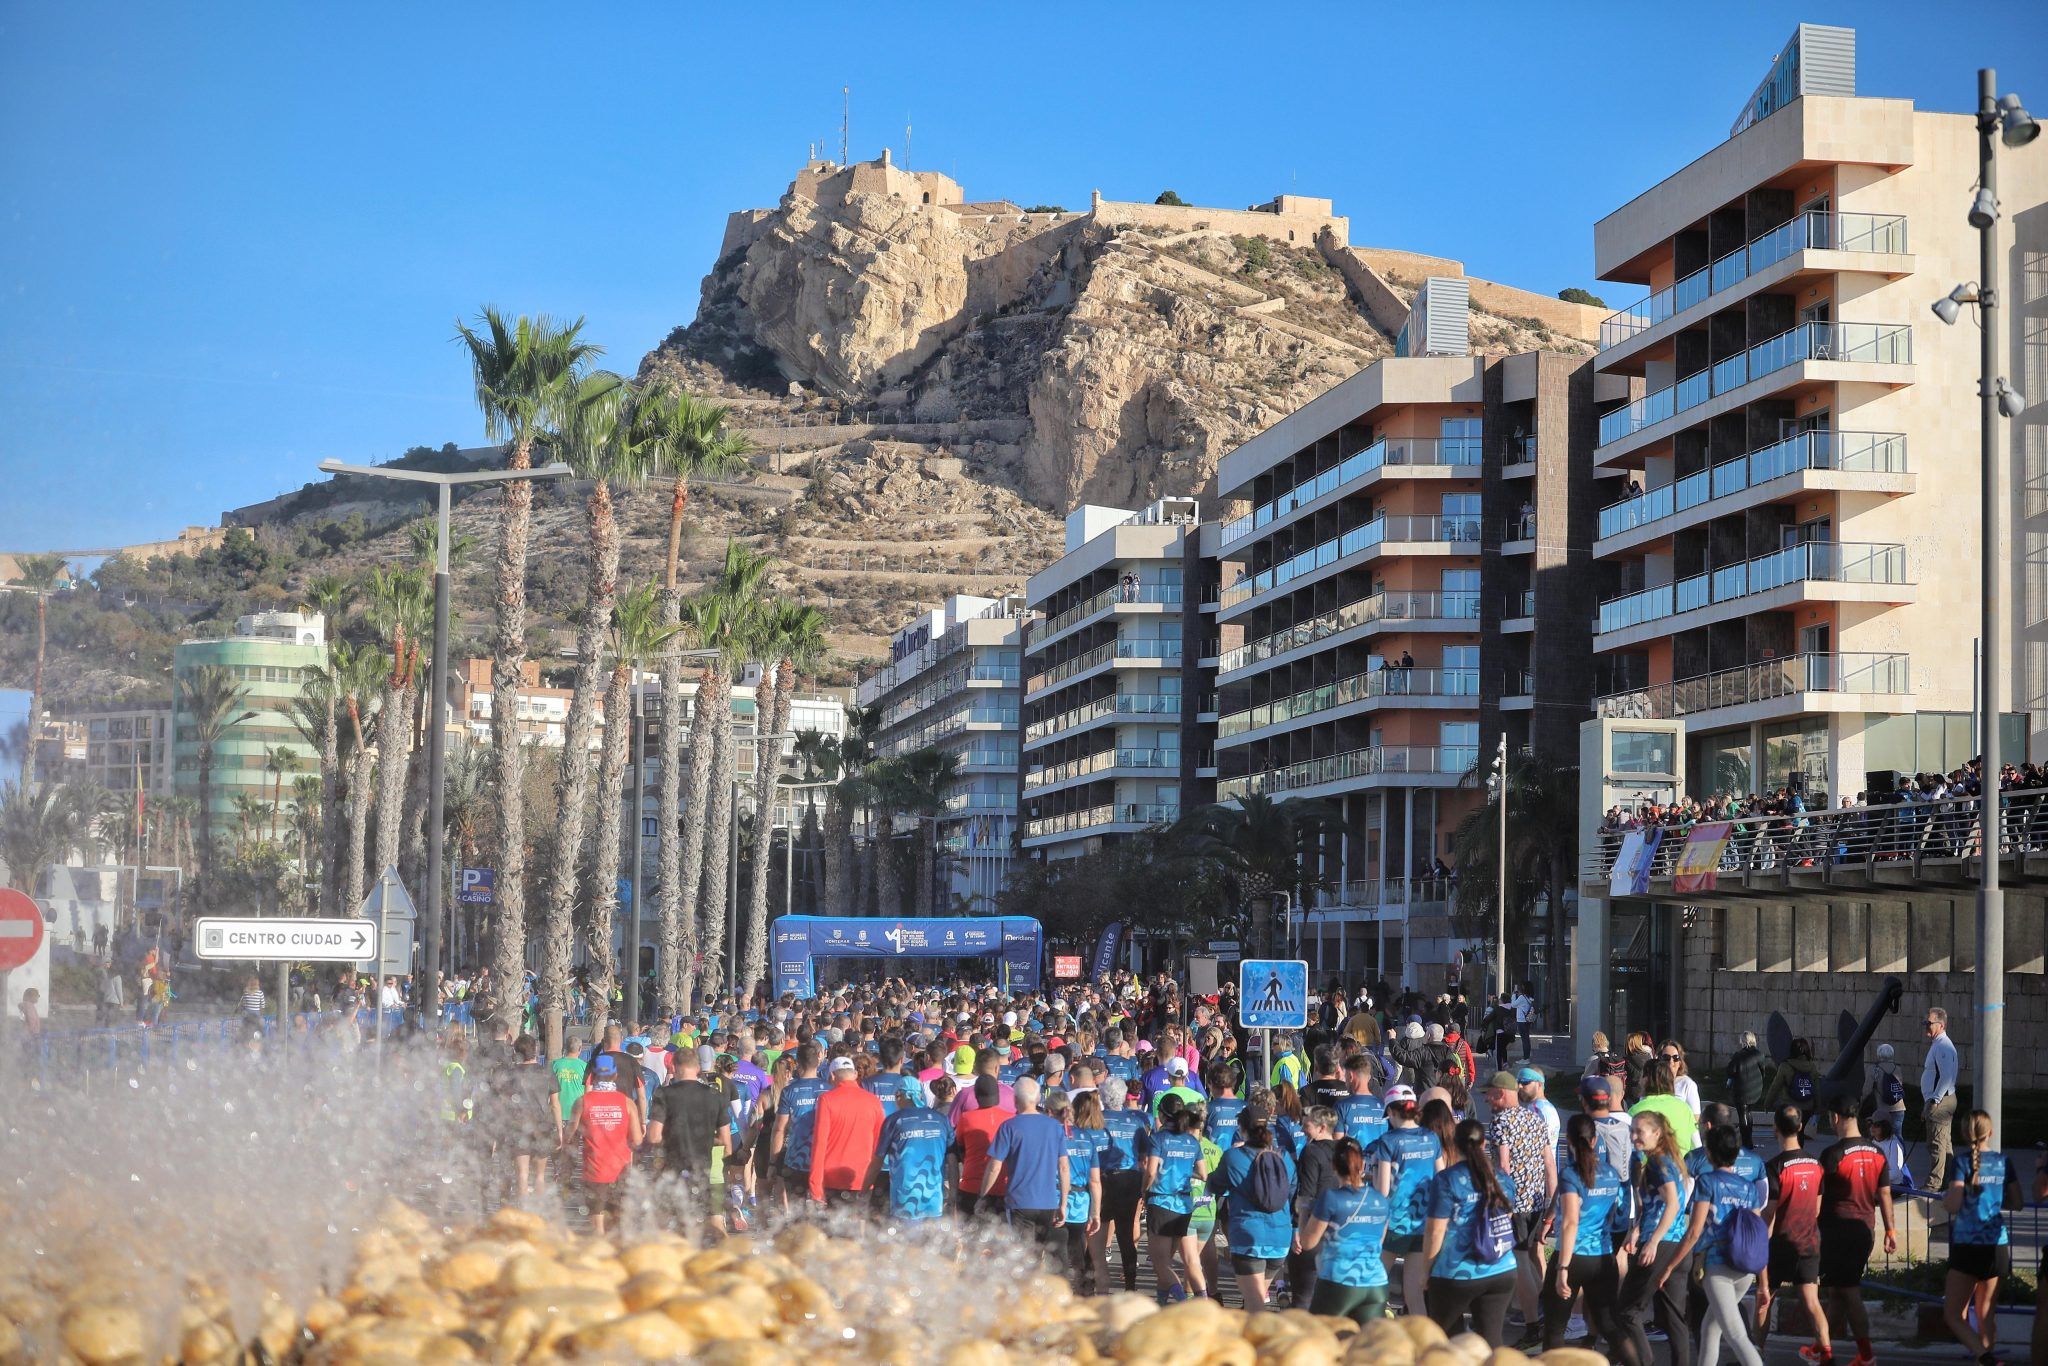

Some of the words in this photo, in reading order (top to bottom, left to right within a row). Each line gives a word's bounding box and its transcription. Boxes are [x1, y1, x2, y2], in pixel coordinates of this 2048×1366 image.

[463, 869, 480, 891] P
[229, 932, 286, 944] CENTRO
[291, 934, 342, 945] CIUDAD
[1353, 1116, 1374, 1124] ALICANTE
[900, 1129, 925, 1140] ALICANTE
[1166, 1150, 1185, 1158] ALICANTE
